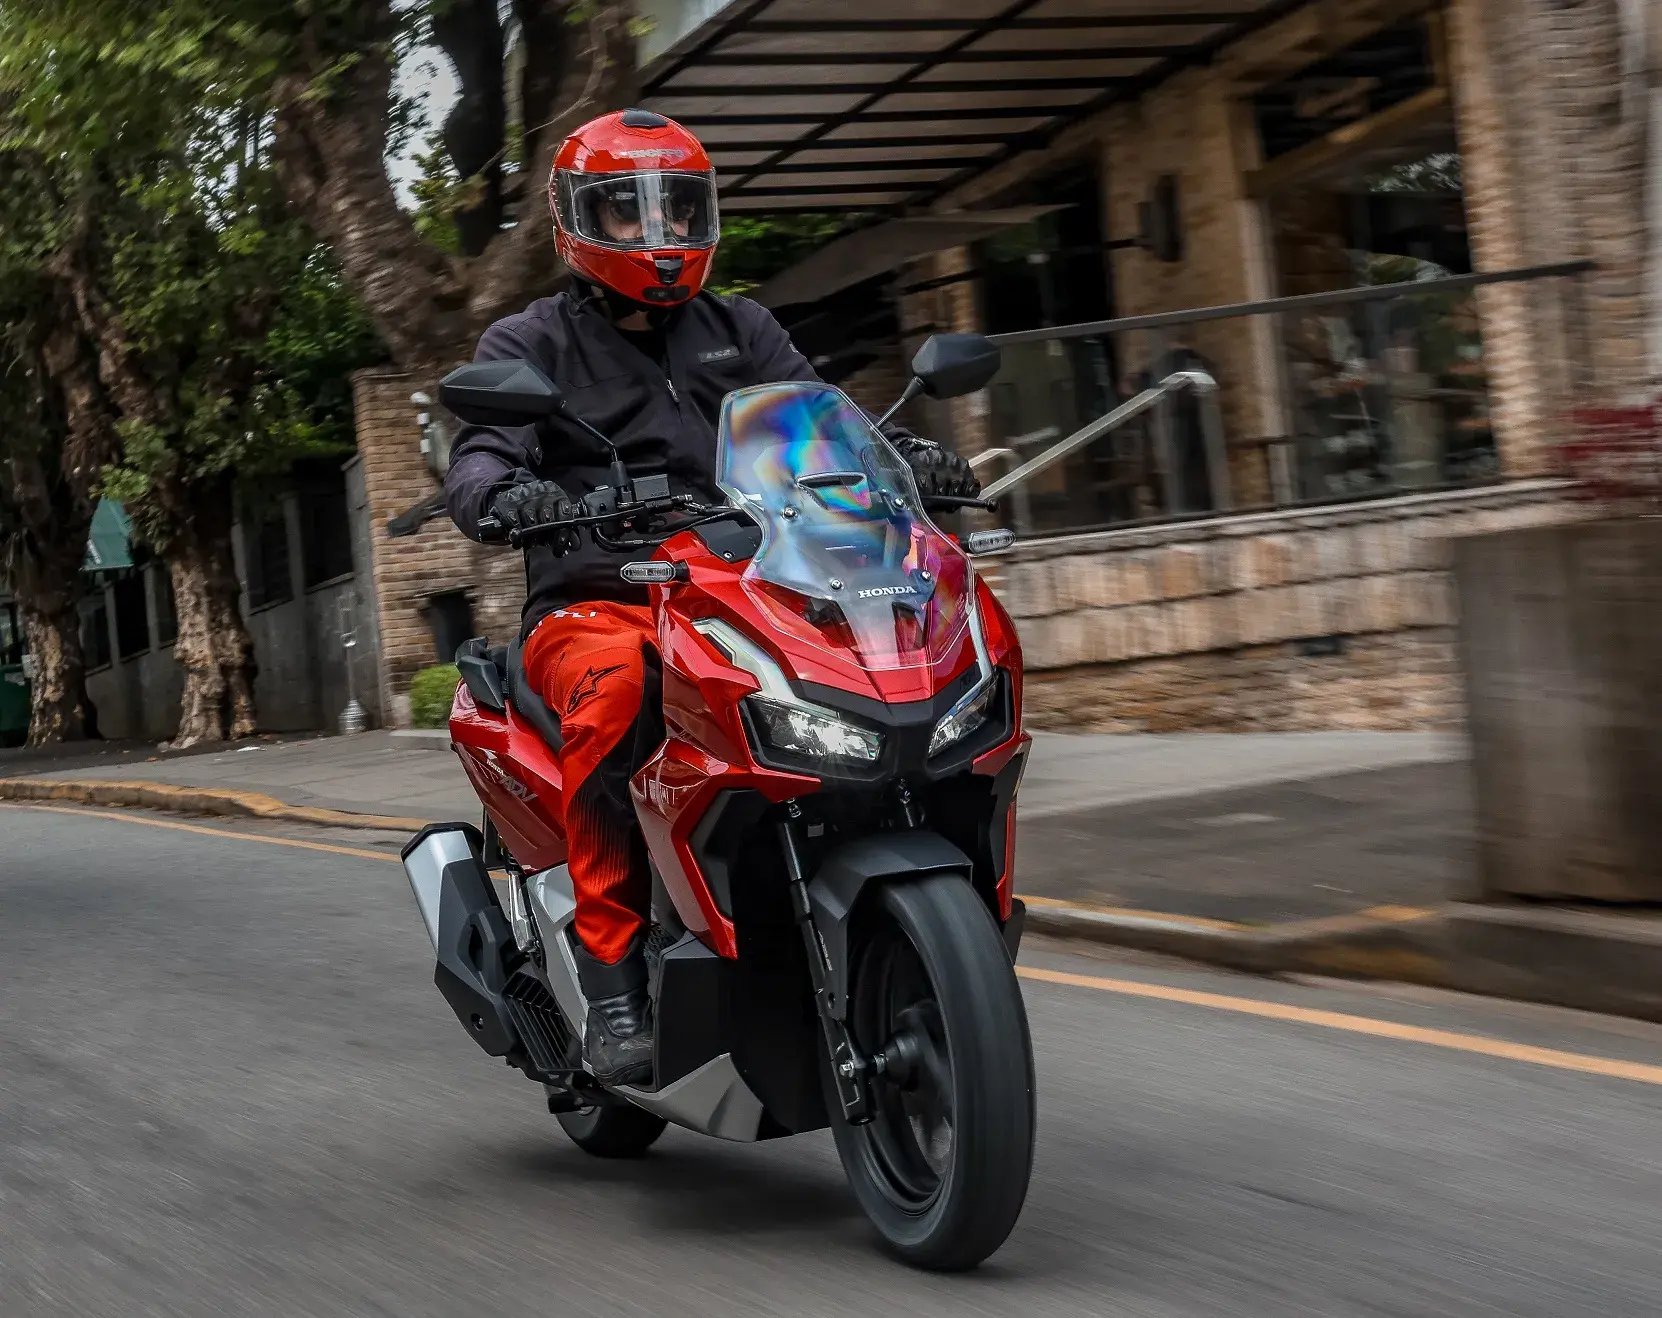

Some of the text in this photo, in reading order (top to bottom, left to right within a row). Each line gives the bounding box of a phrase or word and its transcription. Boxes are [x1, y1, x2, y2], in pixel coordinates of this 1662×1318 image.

[858, 586, 917, 598] HONDA
[486, 759, 504, 776] HONDA
[500, 776, 538, 802] ADV
